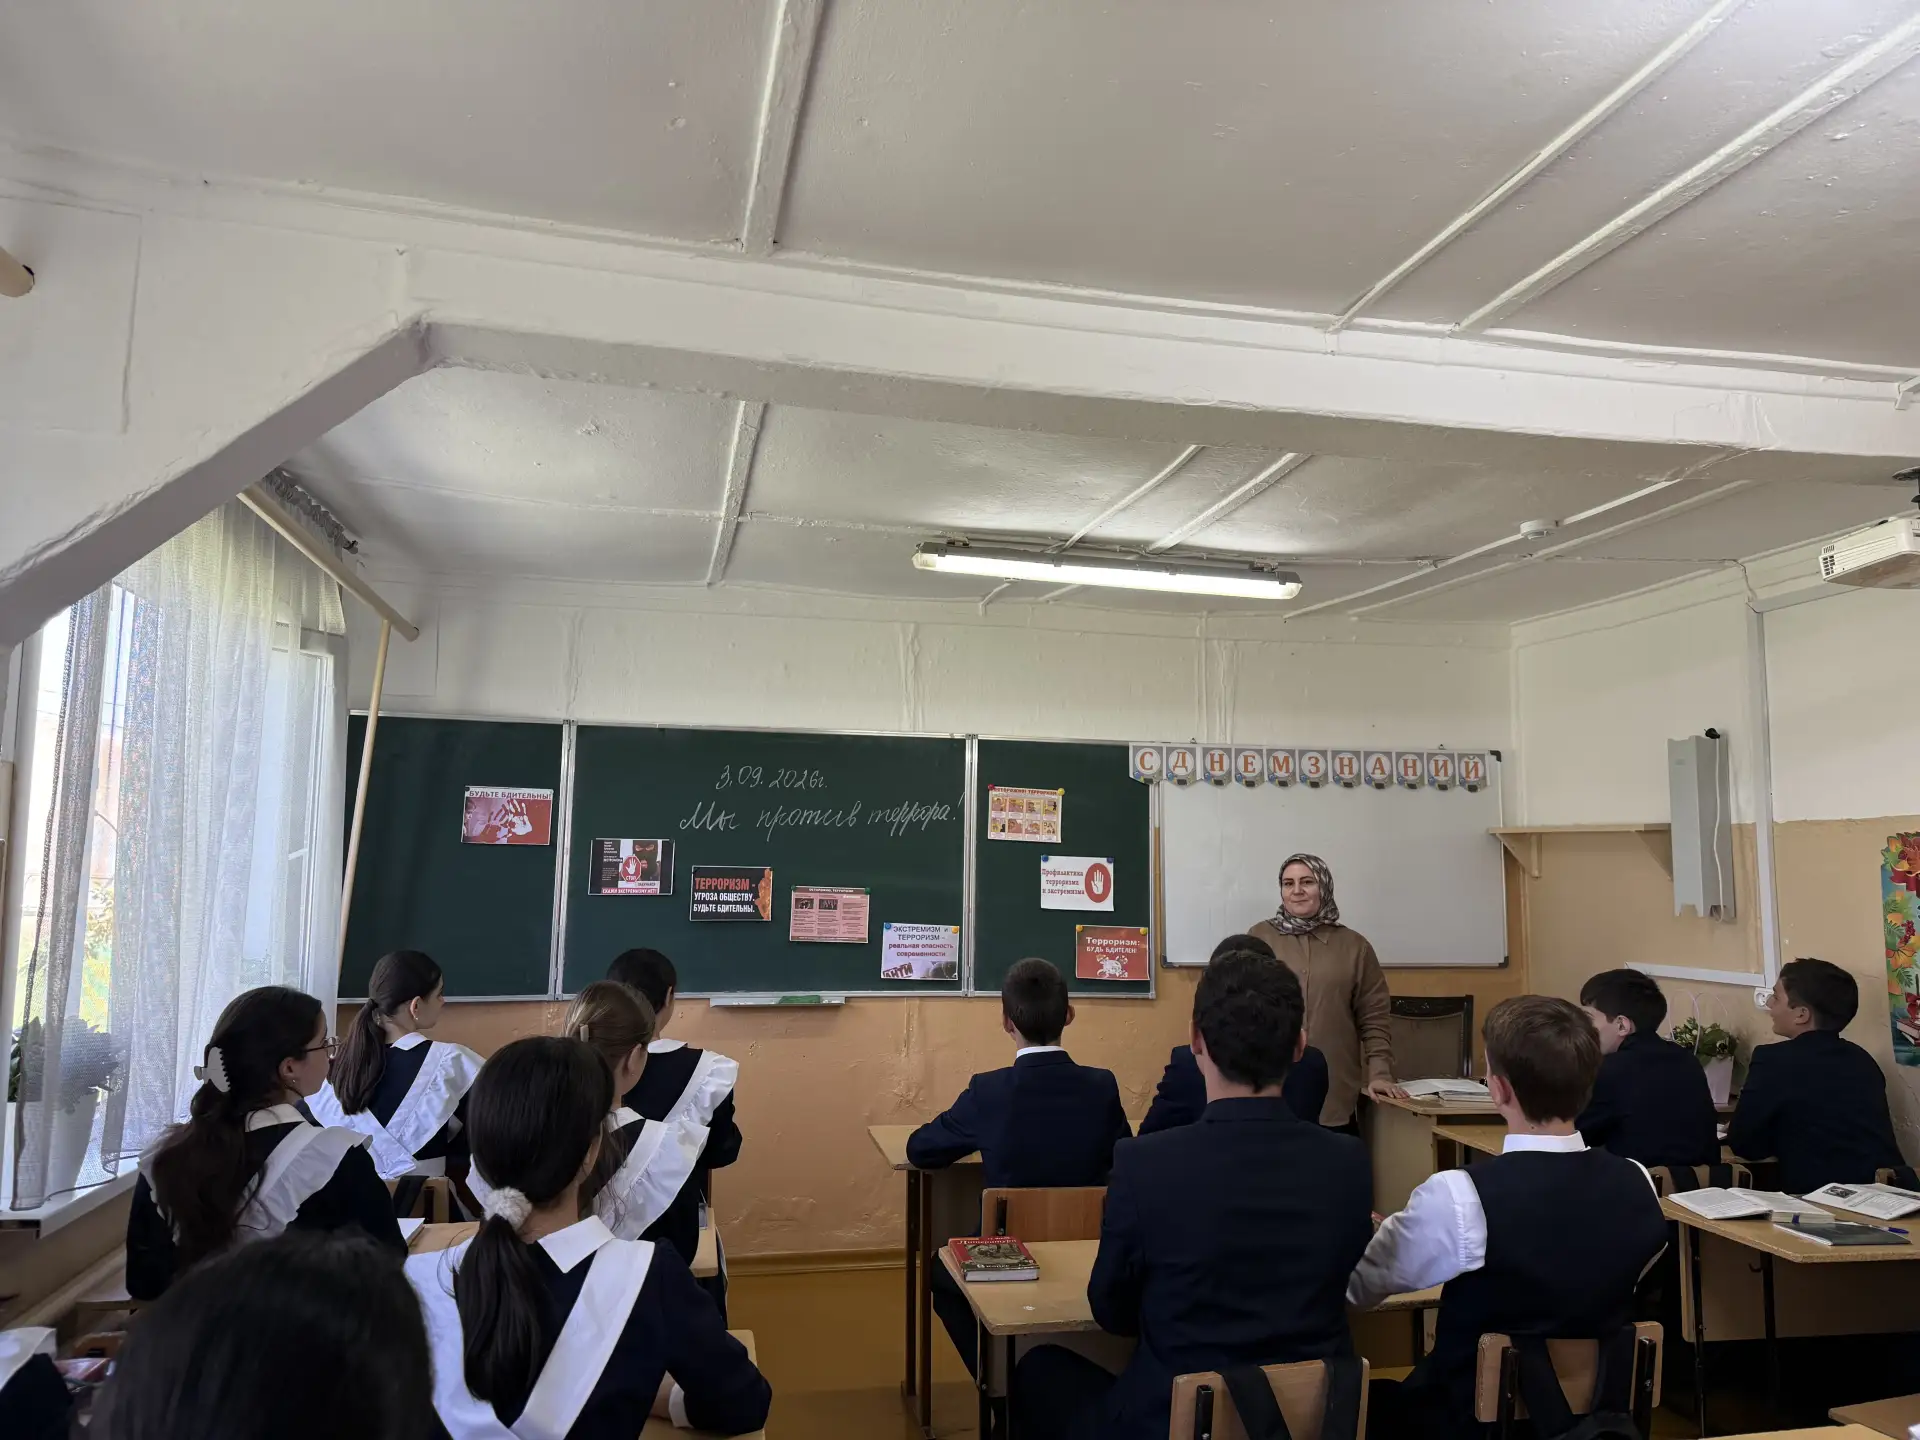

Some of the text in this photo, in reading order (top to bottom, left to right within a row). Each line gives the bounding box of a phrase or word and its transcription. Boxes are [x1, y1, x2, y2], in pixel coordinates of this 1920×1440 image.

[1139, 751, 1153, 771] С
[469, 790, 552, 800] БУДЬТЕ БДИТЕЛЬНЫ!
[679, 791, 966, 842] Мы против террора!
[1042, 869, 1083, 877] Профилактика
[694, 877, 750, 891] ТЕРРОРИЗМ
[694, 892, 755, 902] УГРОЗА ОБЩЕСТВУ.
[693, 903, 755, 913] БУДЬТЕ БДИТЕЛЬНЫ.
[1086, 937, 1140, 946] Терроризм:
